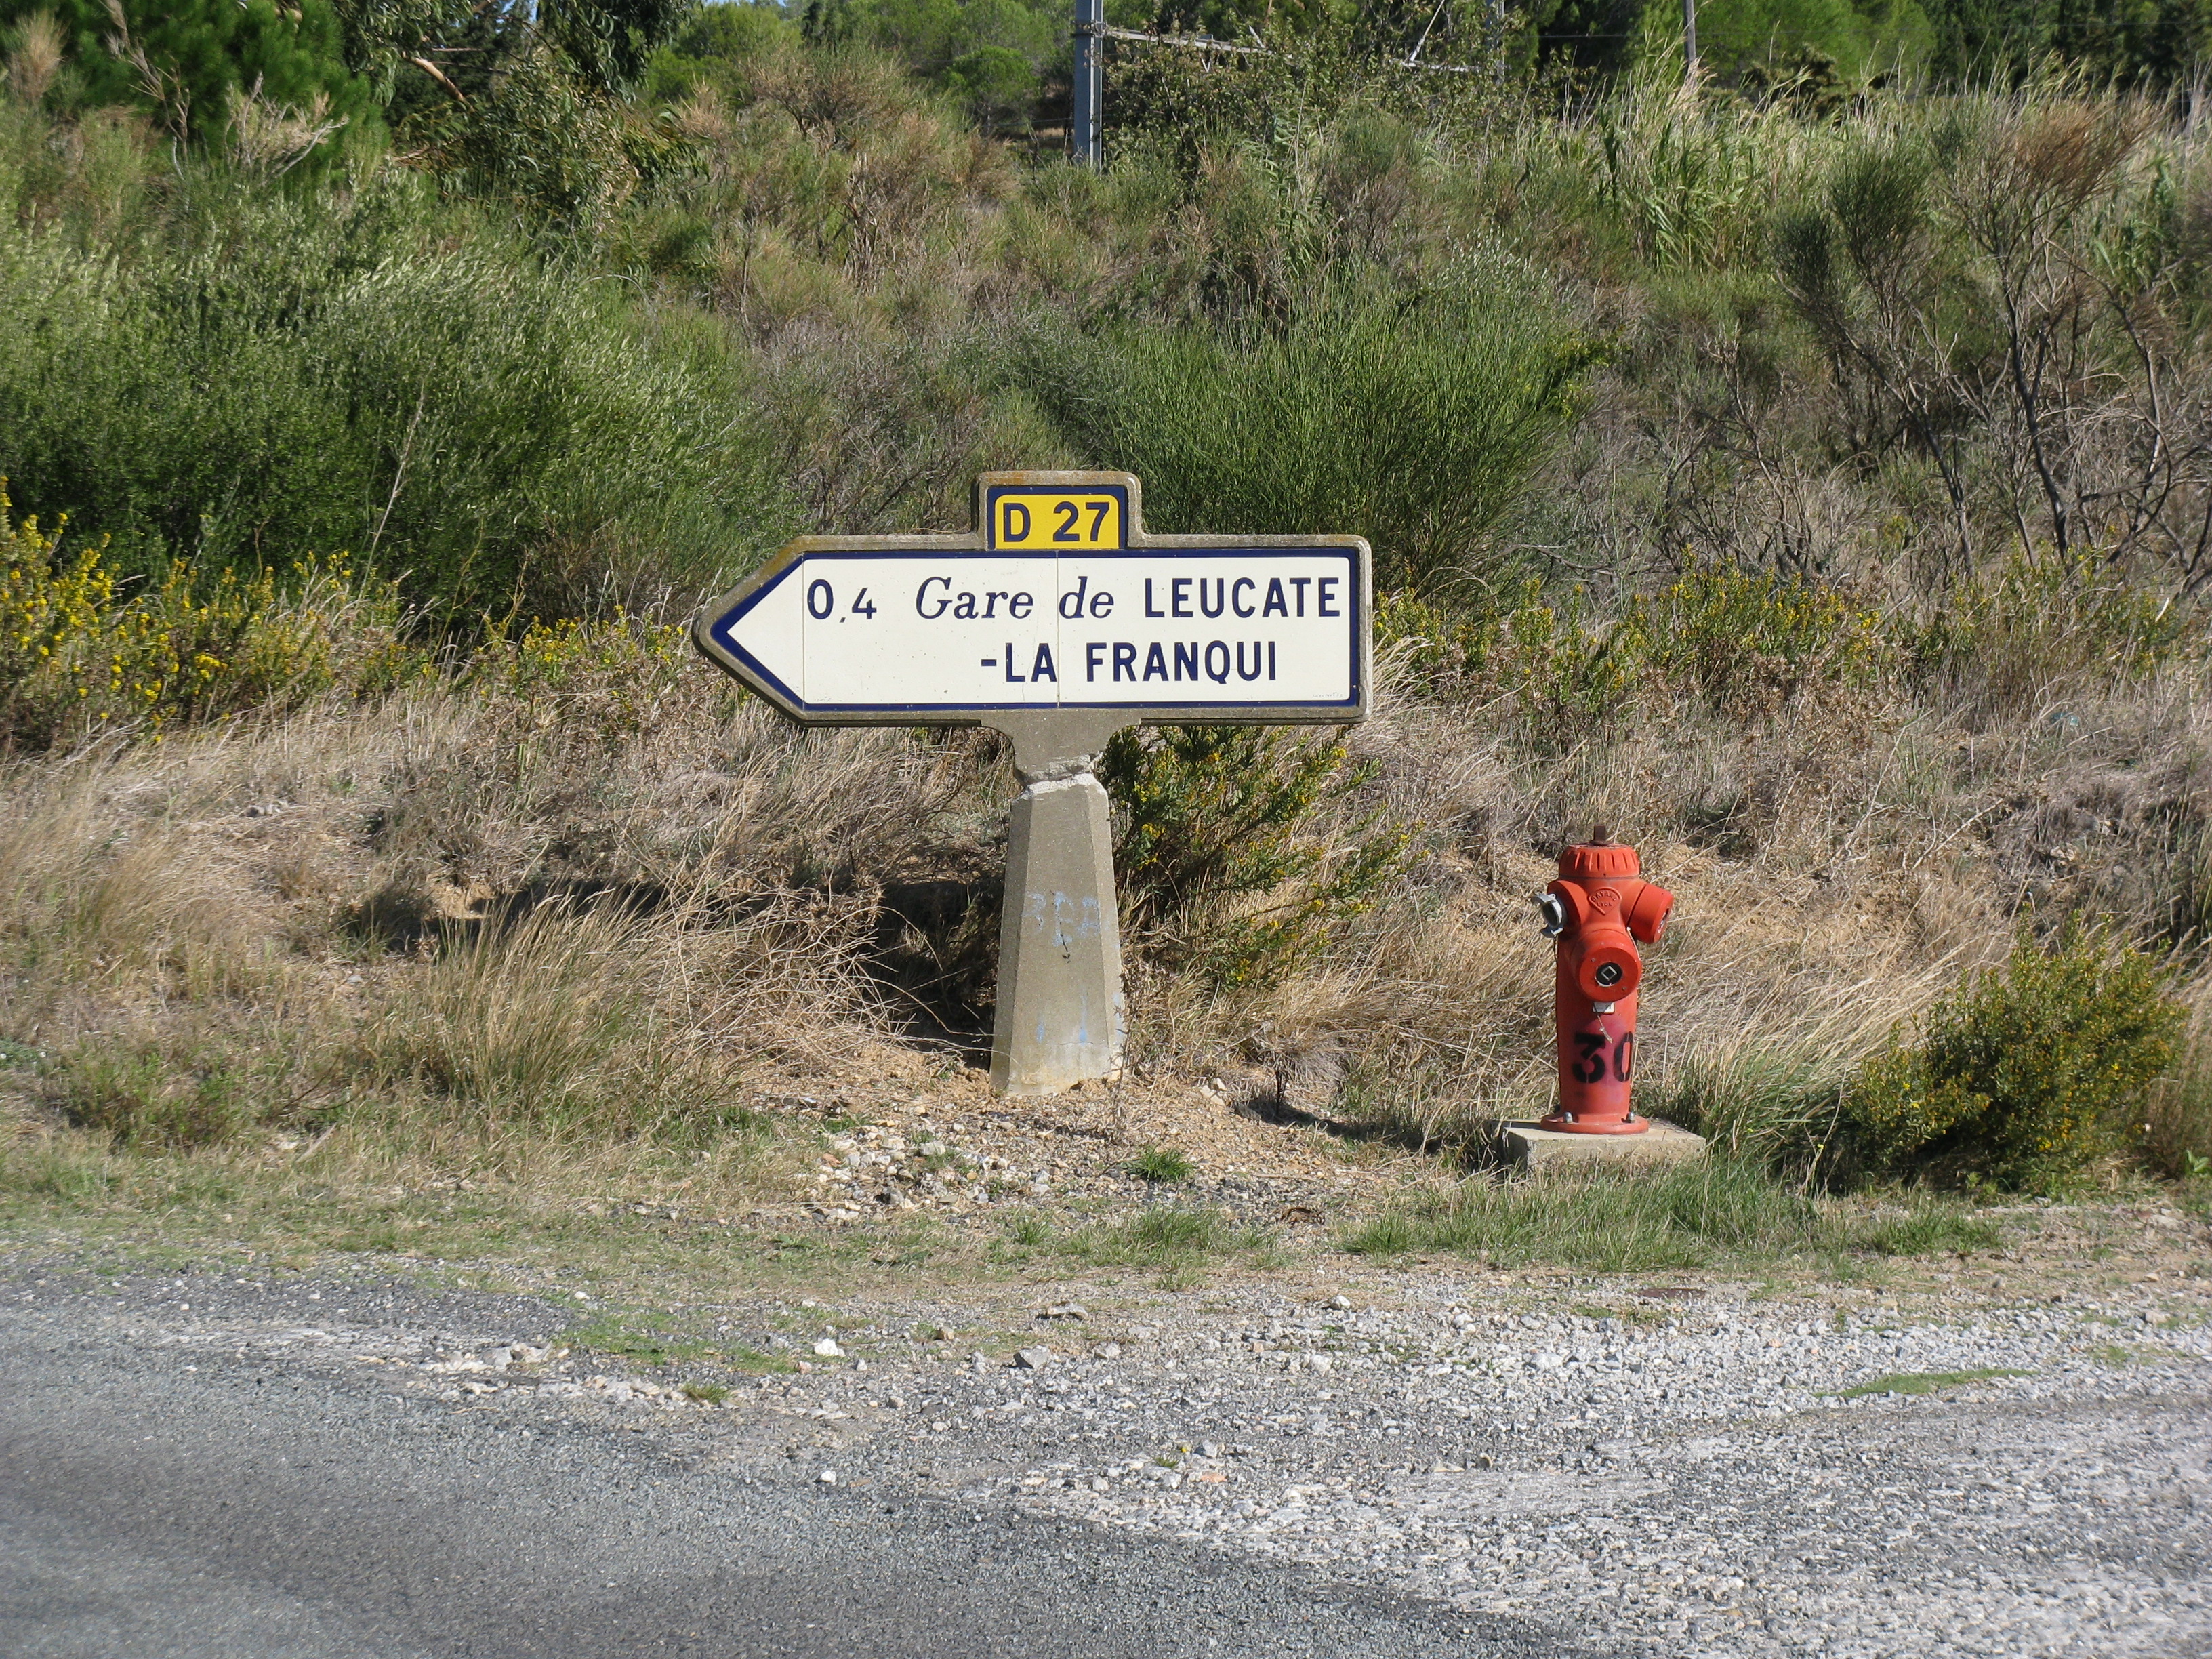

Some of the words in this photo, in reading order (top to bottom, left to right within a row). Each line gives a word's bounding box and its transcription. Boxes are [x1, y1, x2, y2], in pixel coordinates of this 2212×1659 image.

[1003, 502, 1031, 542] D
[1052, 501, 1110, 542] 27
[806, 579, 878, 623] 0,4
[916, 576, 1034, 619] Gare
[1059, 575, 1114, 619] de
[1144, 577, 1340, 619] LEUCATE
[1086, 640, 1276, 684] FRANQUI
[1572, 1031, 1633, 1083] 30
